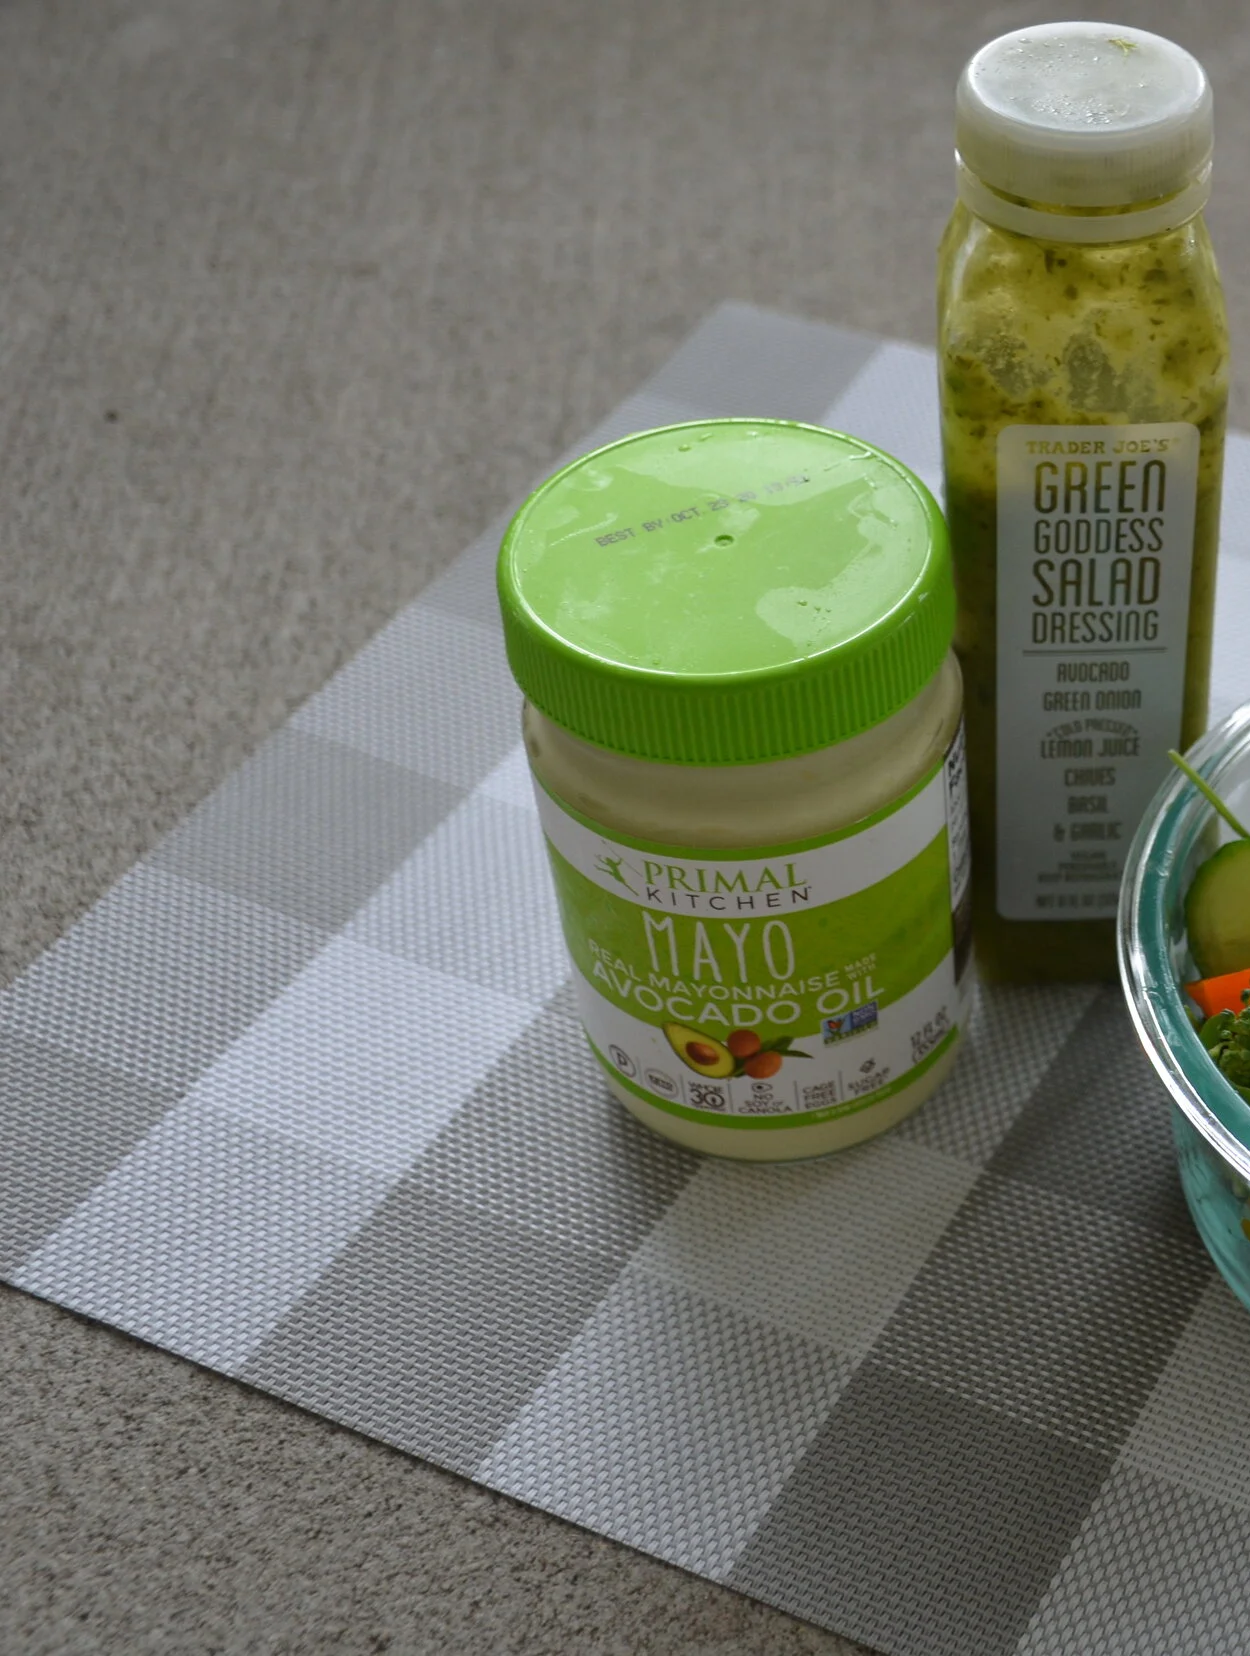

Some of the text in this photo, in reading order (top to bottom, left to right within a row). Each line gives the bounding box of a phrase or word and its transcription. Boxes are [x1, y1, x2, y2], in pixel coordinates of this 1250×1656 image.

[1026, 438, 1170, 455] TRADER JOE'S
[1034, 460, 1166, 514] GREEN
[594, 527, 637, 547] BEST
[1034, 517, 1165, 555] GODDESS
[1032, 556, 1161, 607] SALAD
[1032, 610, 1160, 644] DRESSING
[1057, 661, 1130, 683] AVOCADO
[1043, 689, 1142, 712] GREEN ONION
[1040, 737, 1141, 759] LEMON JUICE
[642, 860, 807, 893] PRIMAL
[646, 886, 811, 911] KITCHEN
[641, 910, 796, 984] MAYO
[589, 937, 841, 1001] REAL MAYONNAISE
[592, 960, 801, 1028] AVOCADO
[816, 975, 885, 1015] OIL
